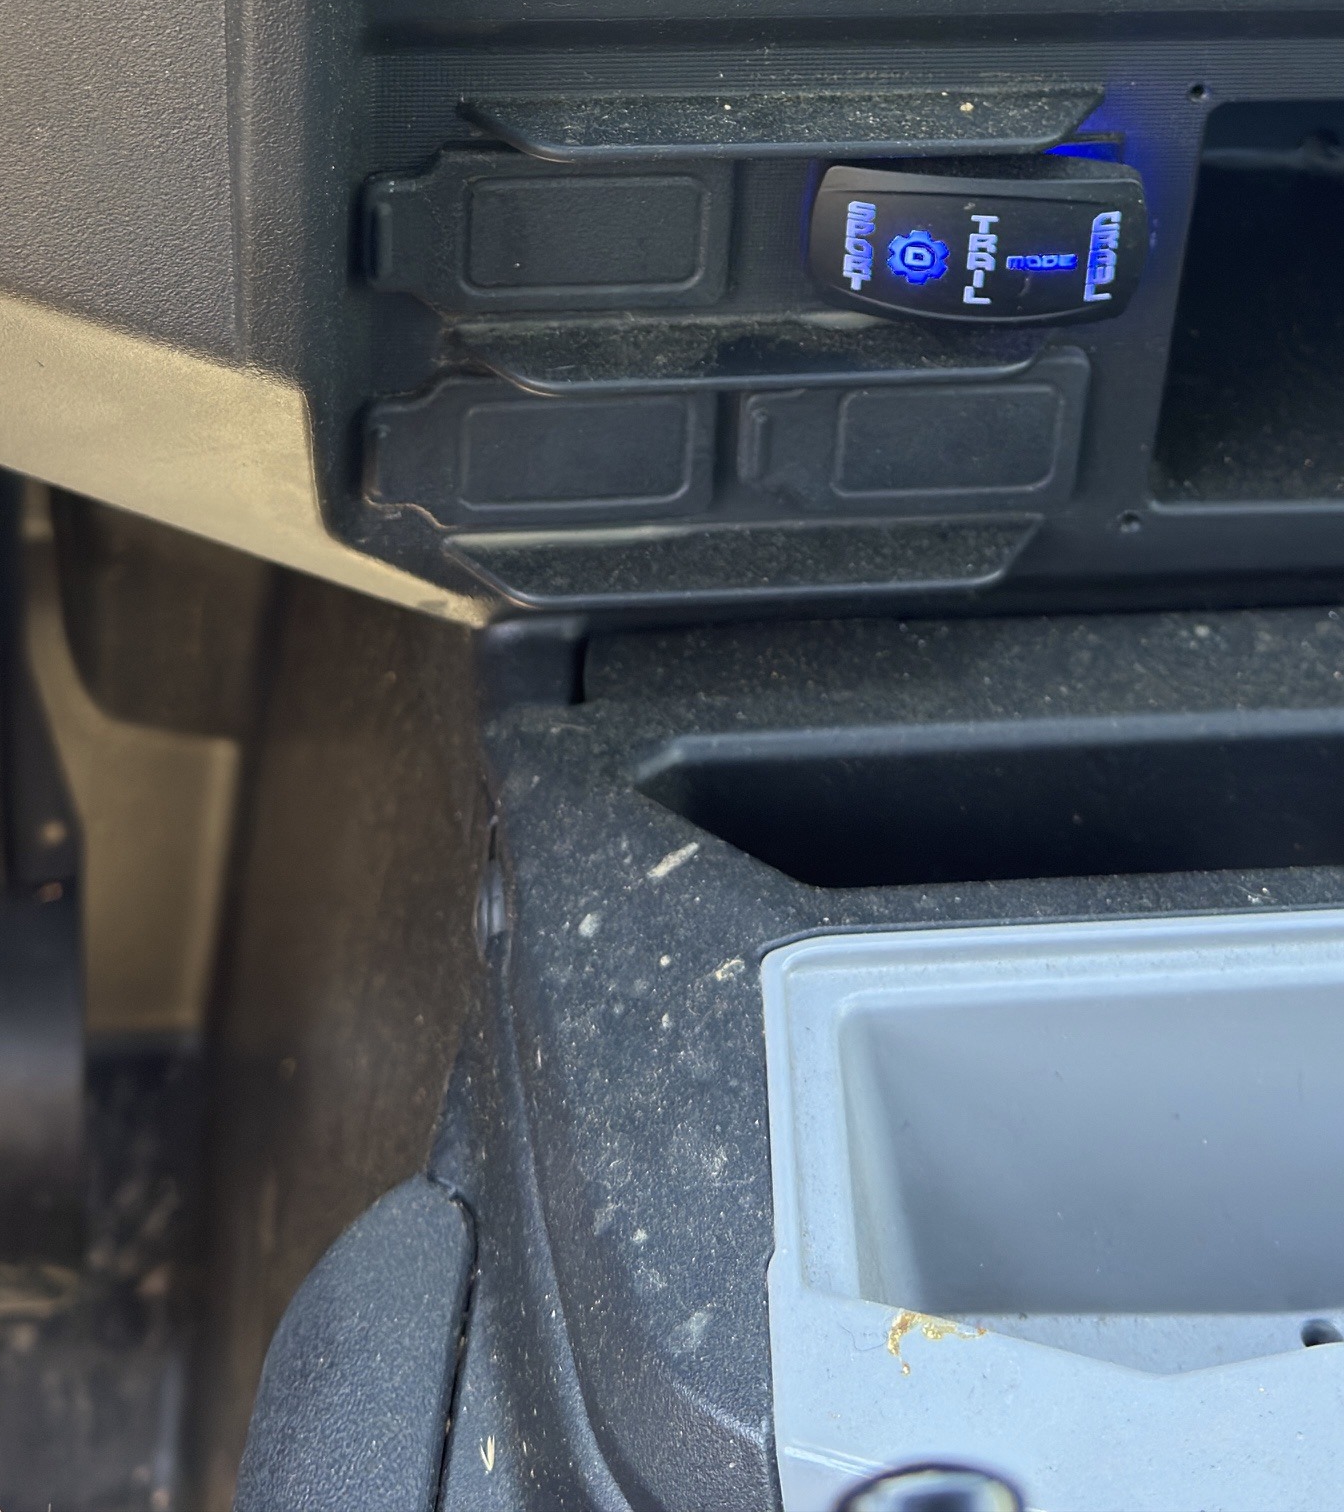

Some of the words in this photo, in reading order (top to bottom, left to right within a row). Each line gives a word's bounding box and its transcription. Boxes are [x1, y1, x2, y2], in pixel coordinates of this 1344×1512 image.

[843, 201, 876, 291] SPORT
[963, 215, 999, 304] TRAIL
[1083, 211, 1122, 302] CRAWL
